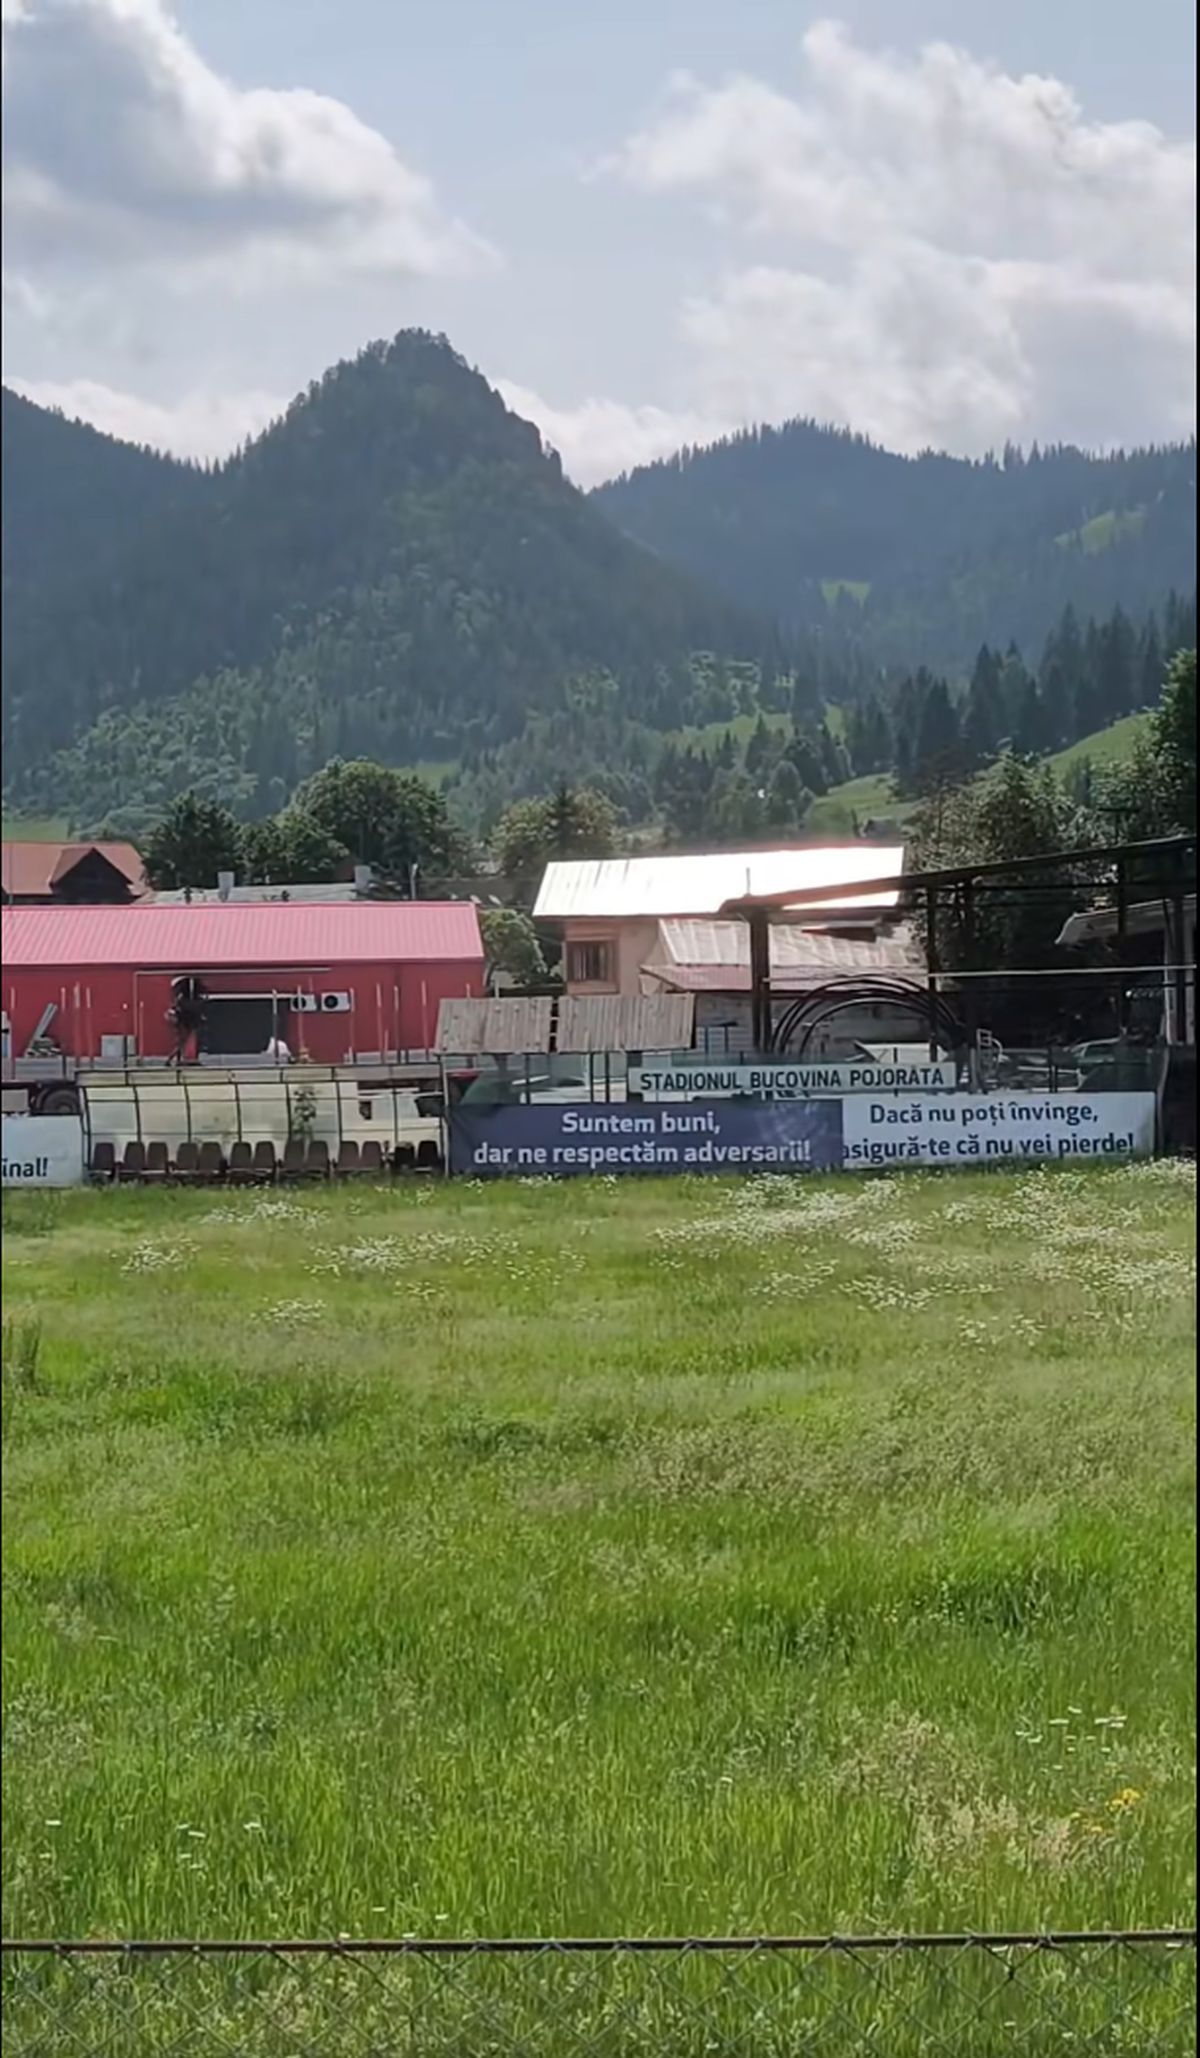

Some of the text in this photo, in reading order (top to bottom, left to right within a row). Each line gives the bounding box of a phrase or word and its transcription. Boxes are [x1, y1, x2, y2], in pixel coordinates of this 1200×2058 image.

[640, 1072, 742, 1090] STADIONUL
[751, 1070, 841, 1089] BUCOVINA
[561, 1111, 721, 1134] Suntem buni,
[870, 1101, 1098, 1127] Dacă nu poți învinge,
[474, 1139, 811, 1169] dar ne respectăm adversarii!
[956, 1134, 979, 1155] că
[986, 1139, 1013, 1154] nu
[1020, 1134, 1051, 1154] vei
[1058, 1133, 1134, 1158] pierde!
